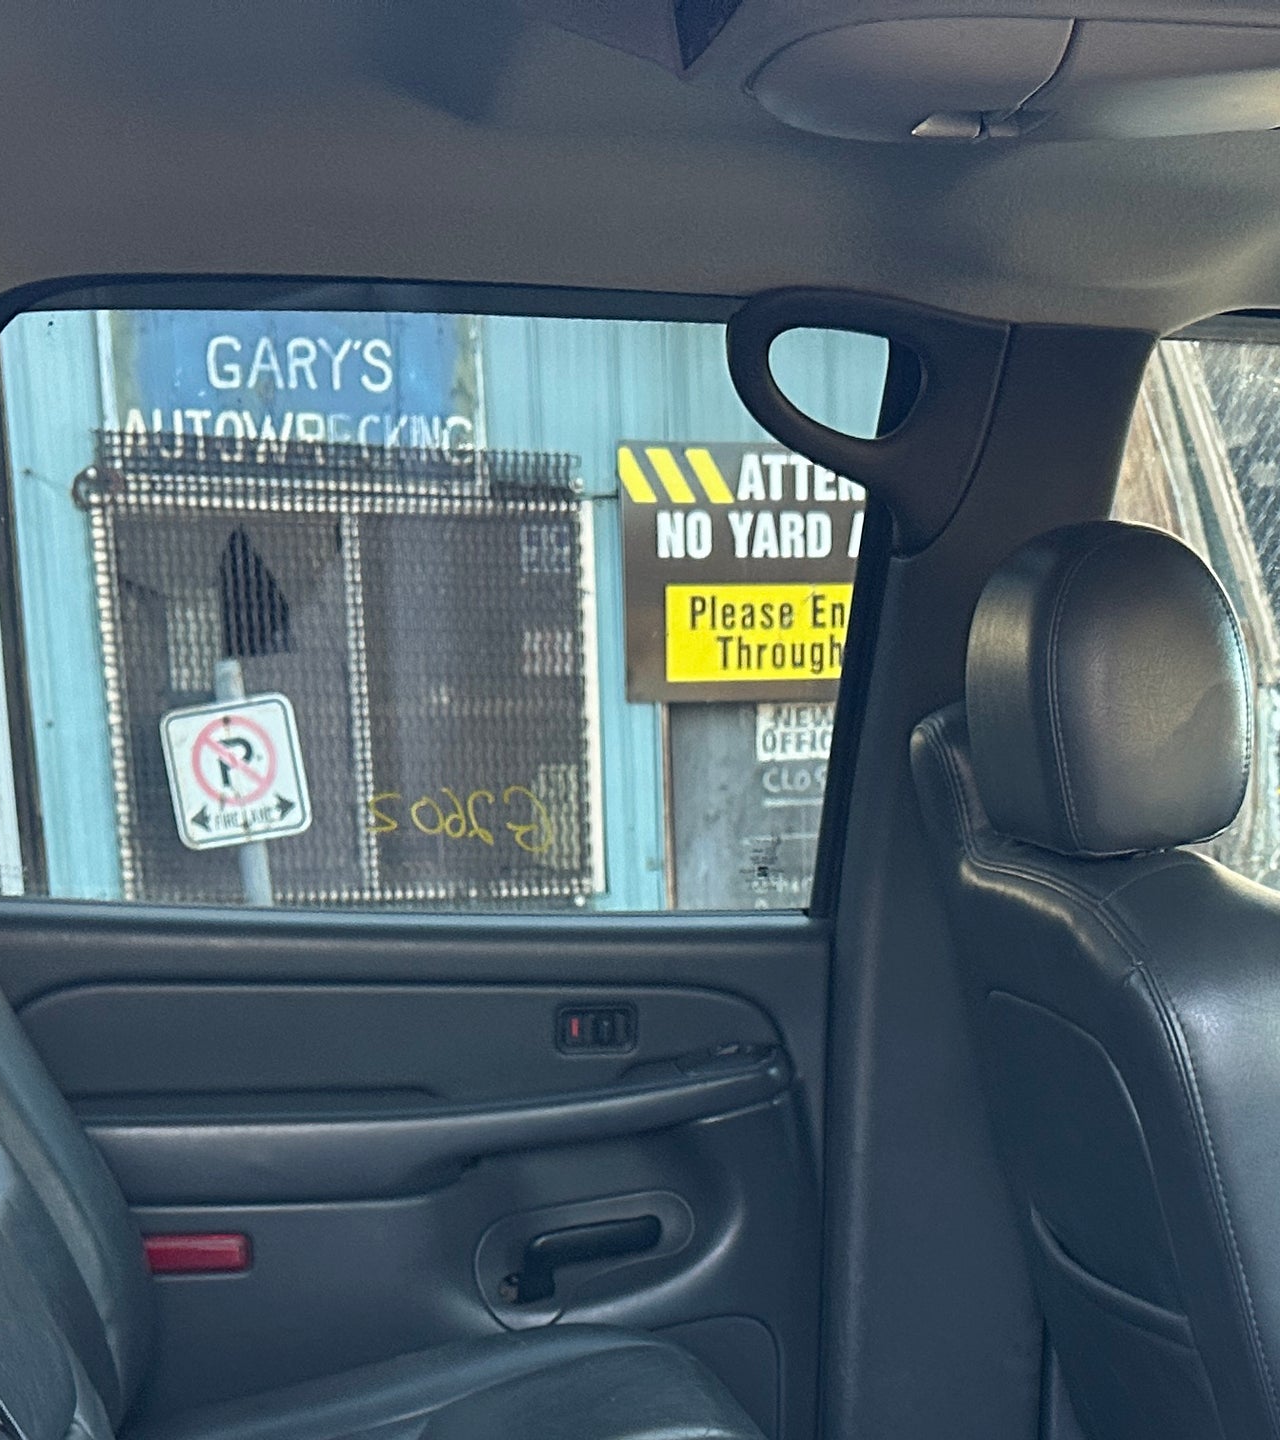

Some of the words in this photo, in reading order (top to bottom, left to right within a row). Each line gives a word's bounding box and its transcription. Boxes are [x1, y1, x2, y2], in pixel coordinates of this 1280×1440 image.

[205, 335, 393, 393] GARY'S
[656, 509, 713, 560] NO
[727, 509, 834, 559] YARD
[689, 594, 795, 631] Please
[811, 593, 846, 630] En
[716, 634, 843, 675] Through
